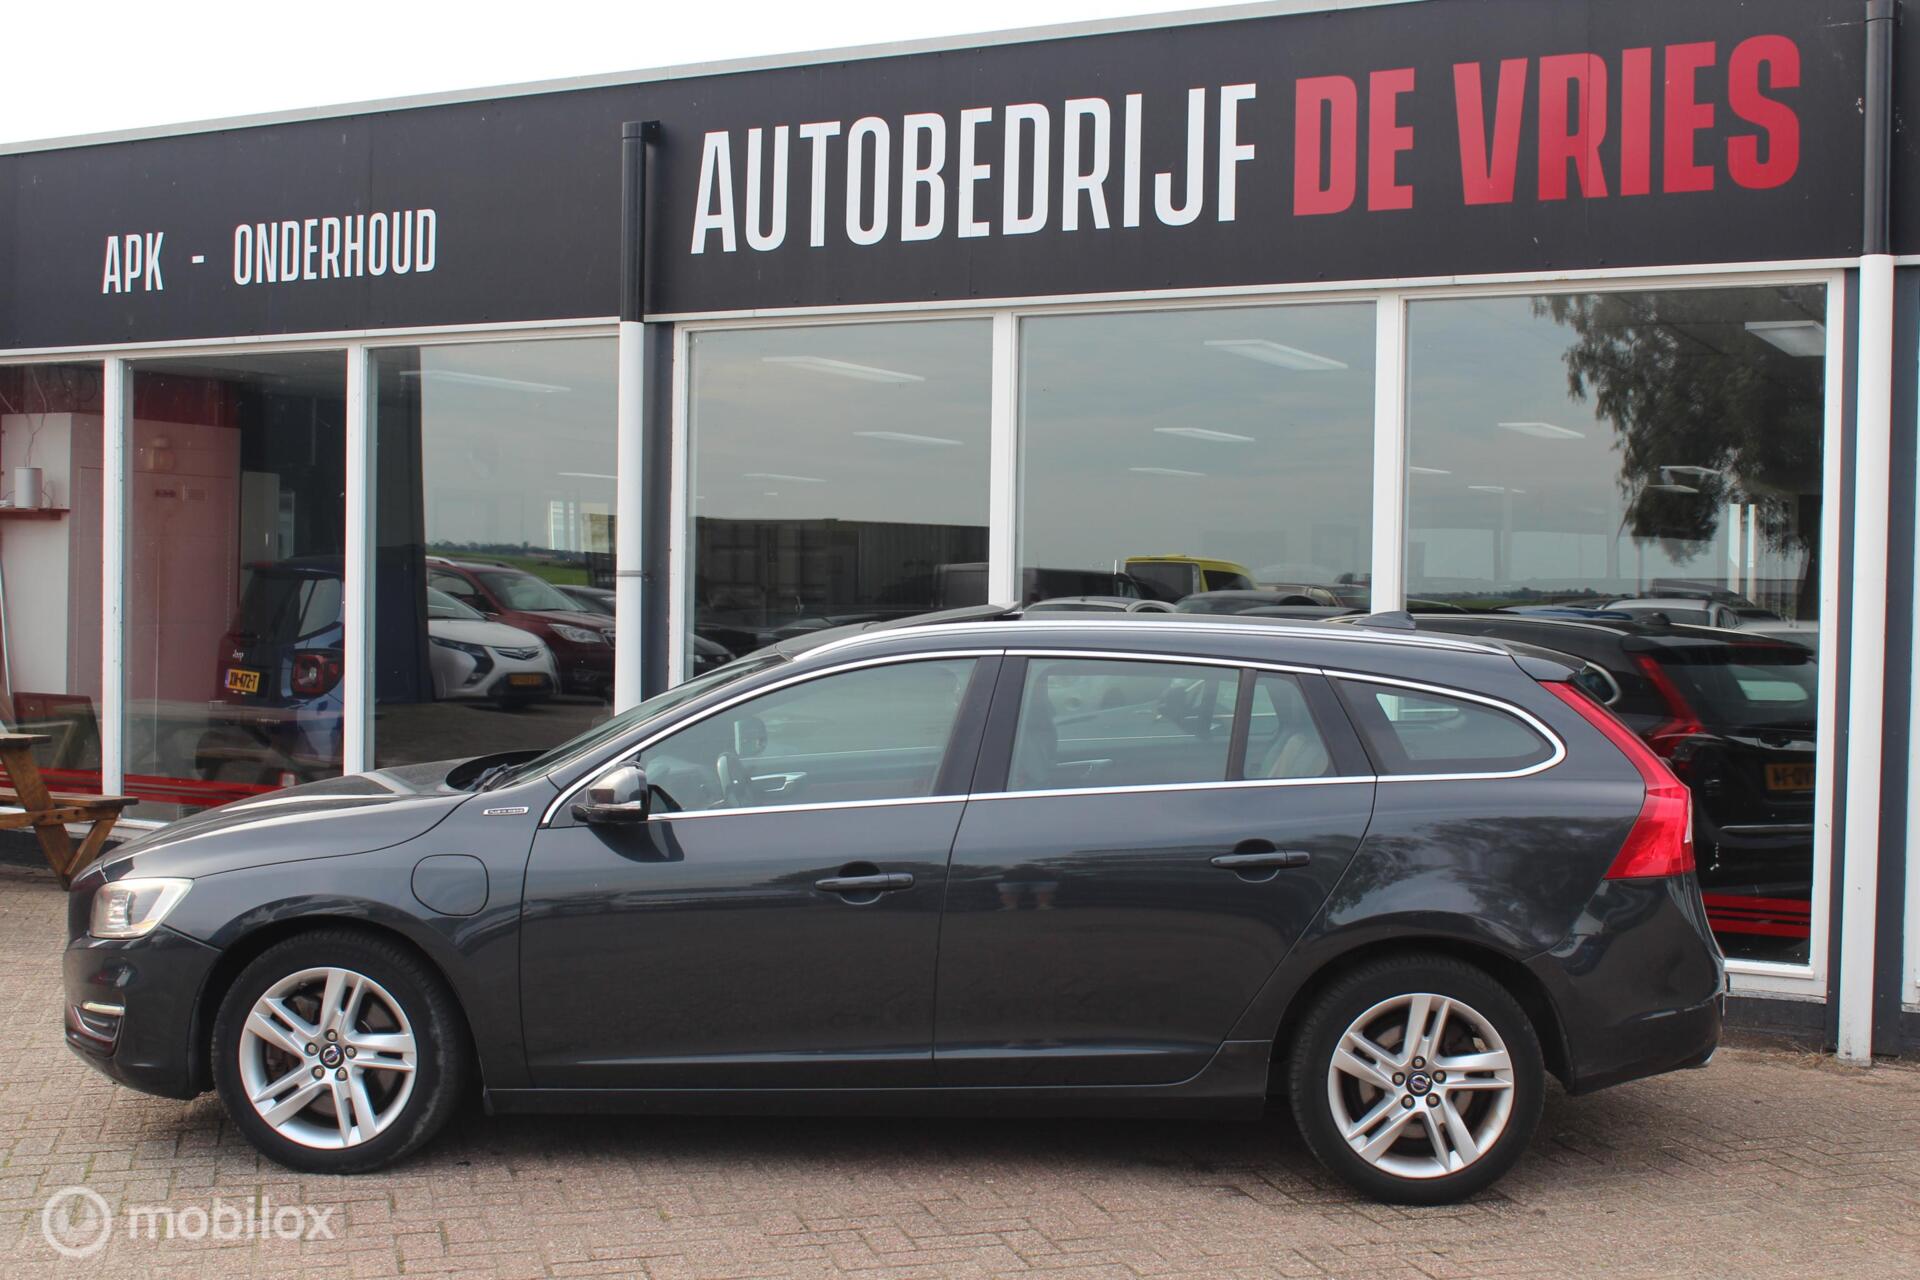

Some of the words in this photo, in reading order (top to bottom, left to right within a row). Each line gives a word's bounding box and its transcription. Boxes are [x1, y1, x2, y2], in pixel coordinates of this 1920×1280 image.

[690, 83, 1257, 254] AUTOBEDRIJF
[1293, 67, 1416, 216] DE
[1453, 35, 1801, 206] VRIES
[102, 231, 164, 294] APK
[191, 255, 205, 264] -
[233, 208, 436, 286] ONDERHOUD
